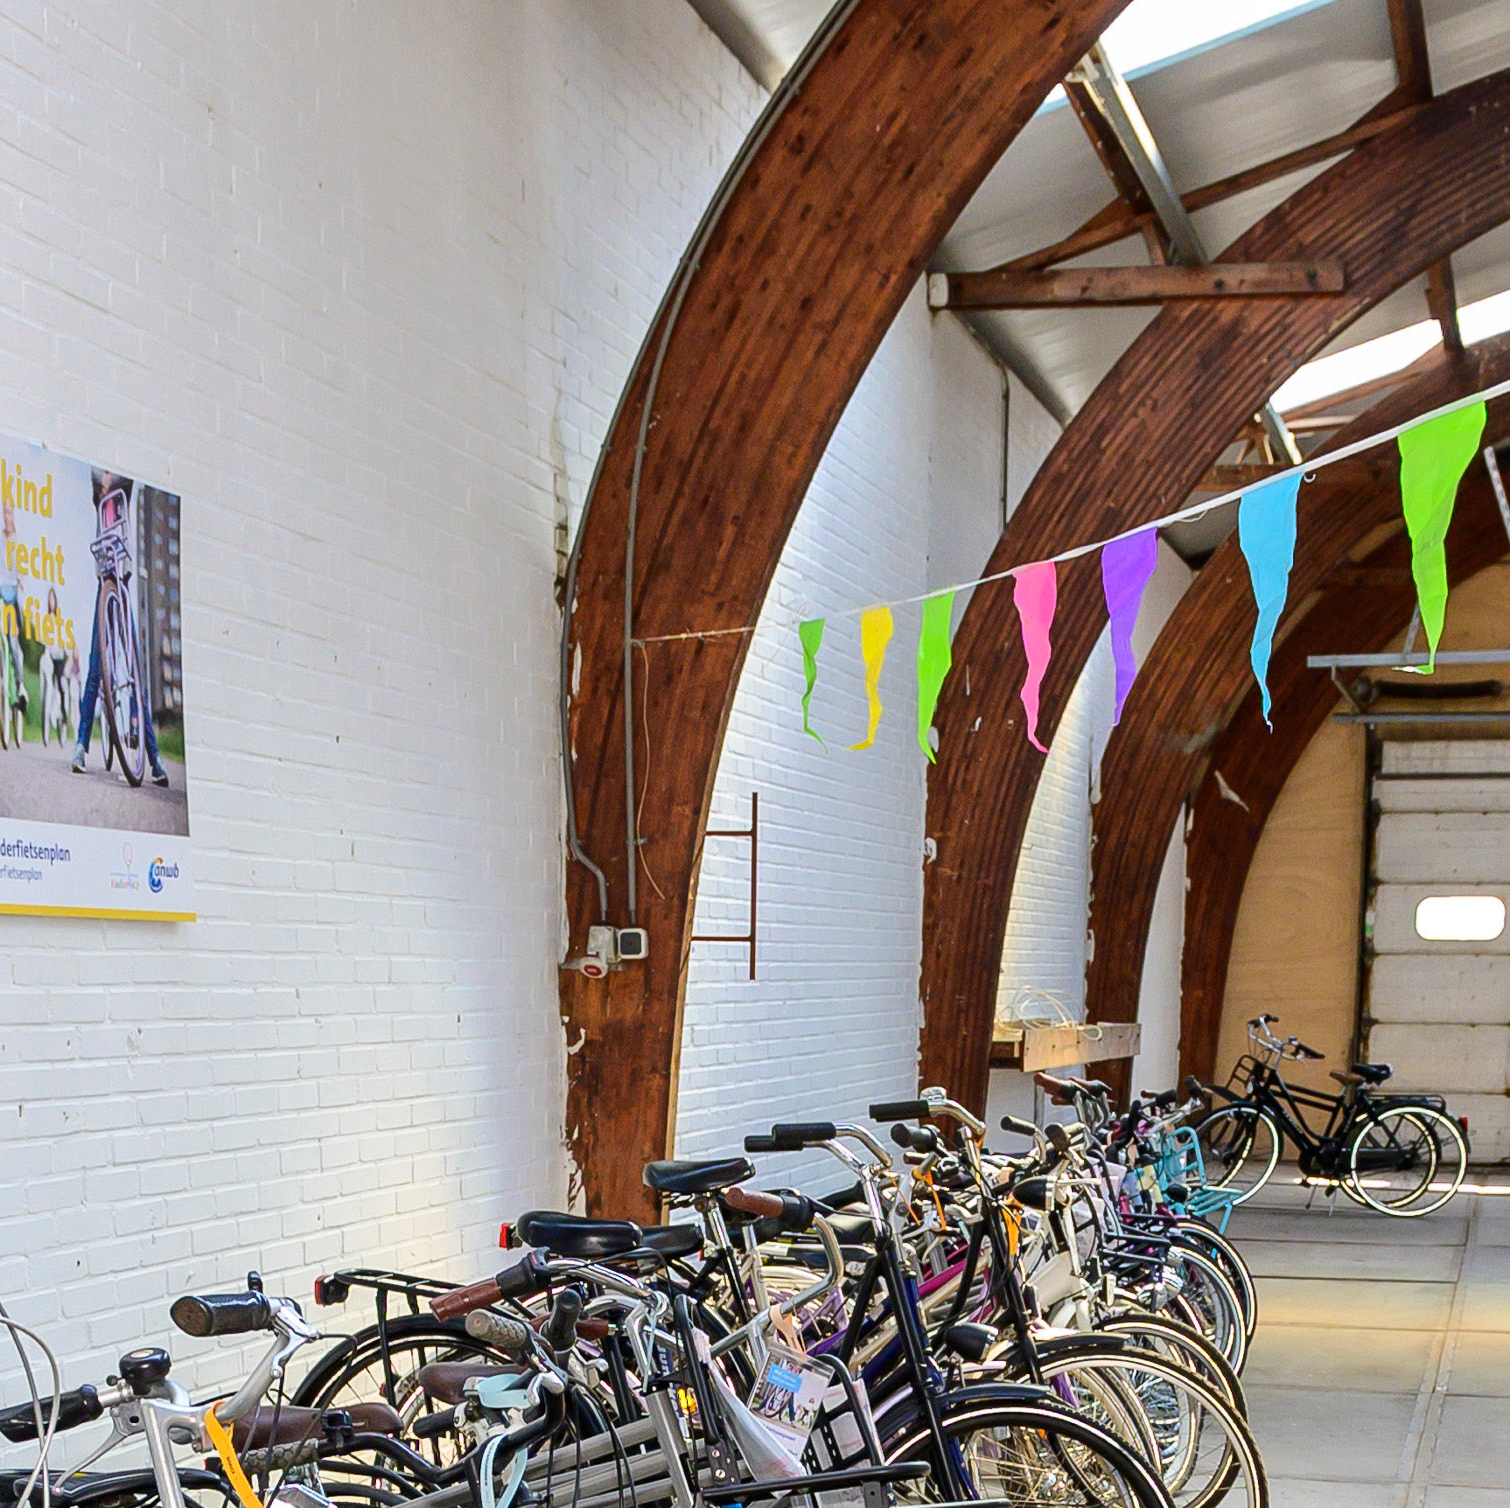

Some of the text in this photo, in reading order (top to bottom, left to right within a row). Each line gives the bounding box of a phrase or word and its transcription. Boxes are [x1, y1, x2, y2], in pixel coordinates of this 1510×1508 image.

[1, 458, 52, 518] kind
[6, 536, 65, 586] recht
[23, 596, 74, 649] fiets
